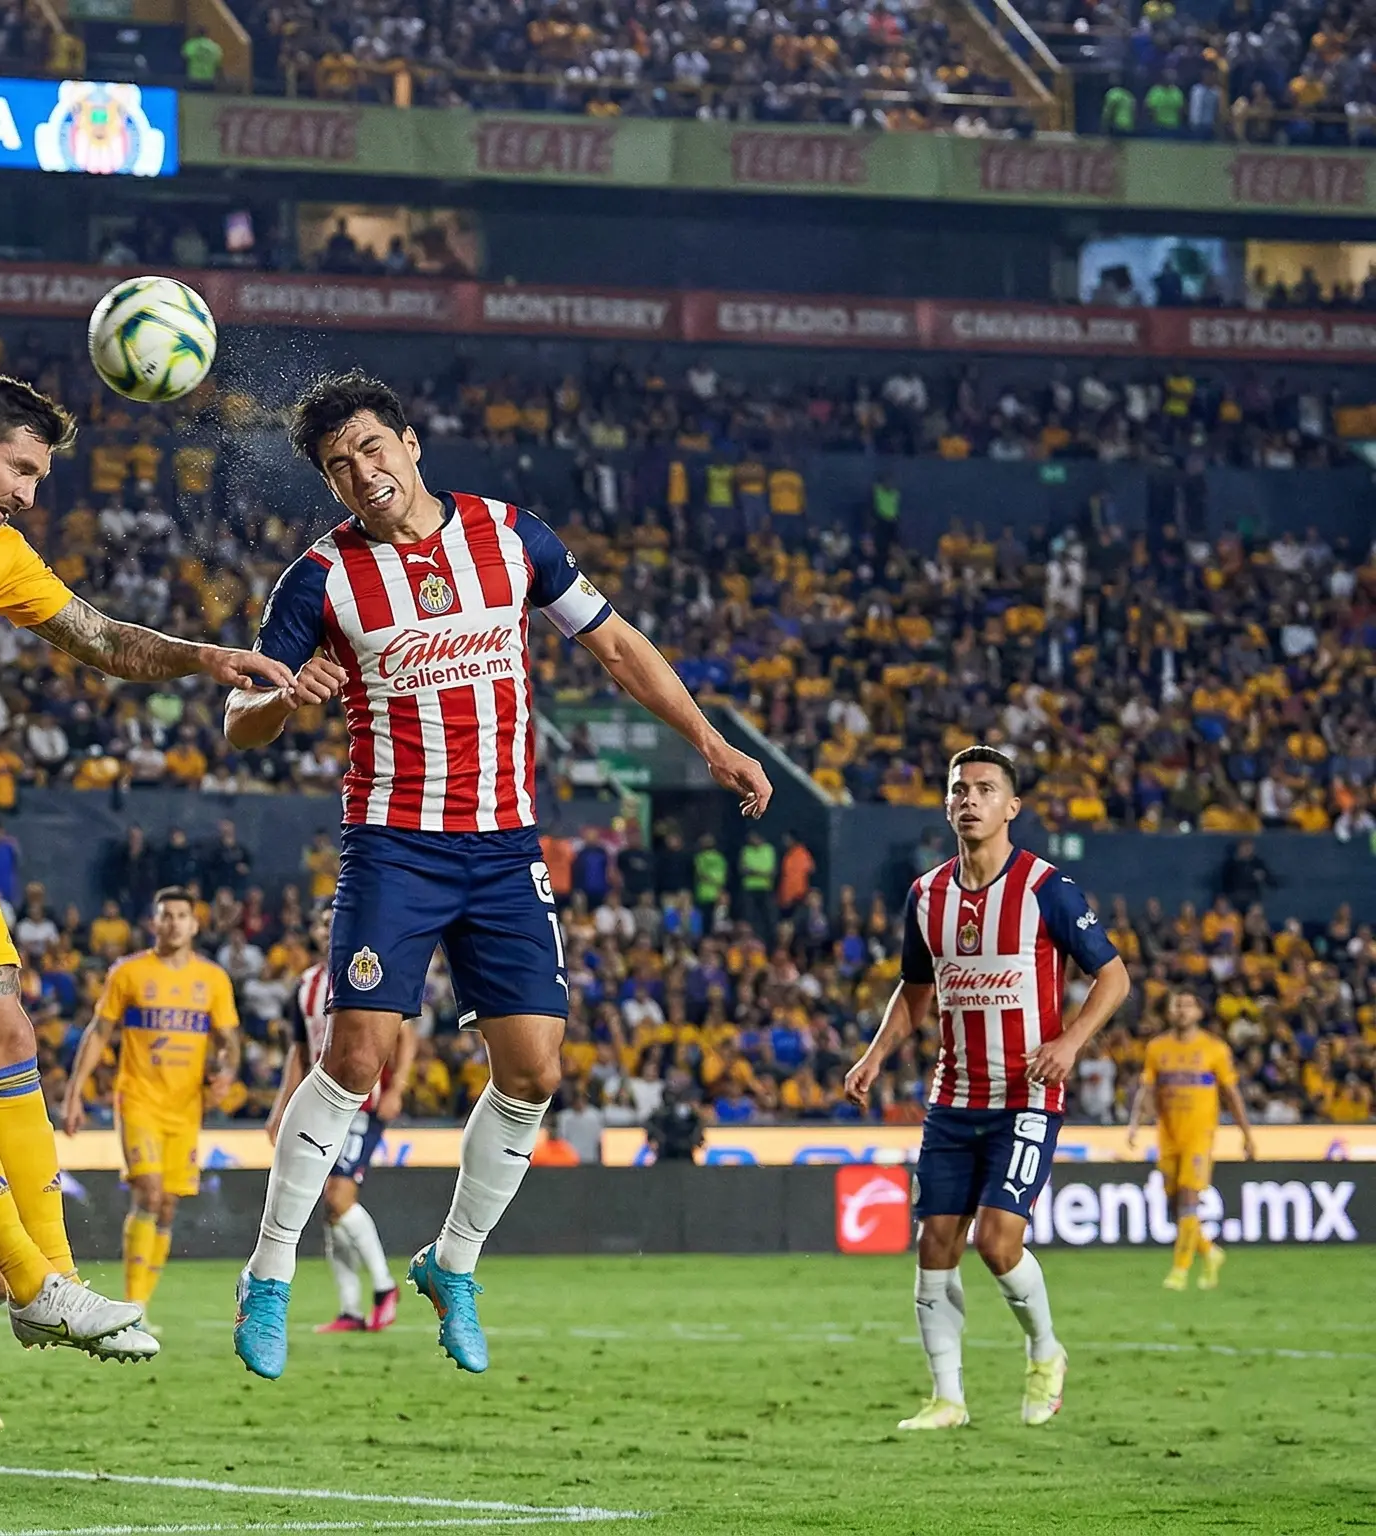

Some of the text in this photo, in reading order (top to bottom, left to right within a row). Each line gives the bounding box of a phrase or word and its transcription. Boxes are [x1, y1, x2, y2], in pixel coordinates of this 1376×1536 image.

[373, 626, 512, 679] Caliente
[393, 657, 513, 691] caliente.mx
[1006, 1139, 1041, 1185] 10
[1023, 1169, 1359, 1245] iente.mx
